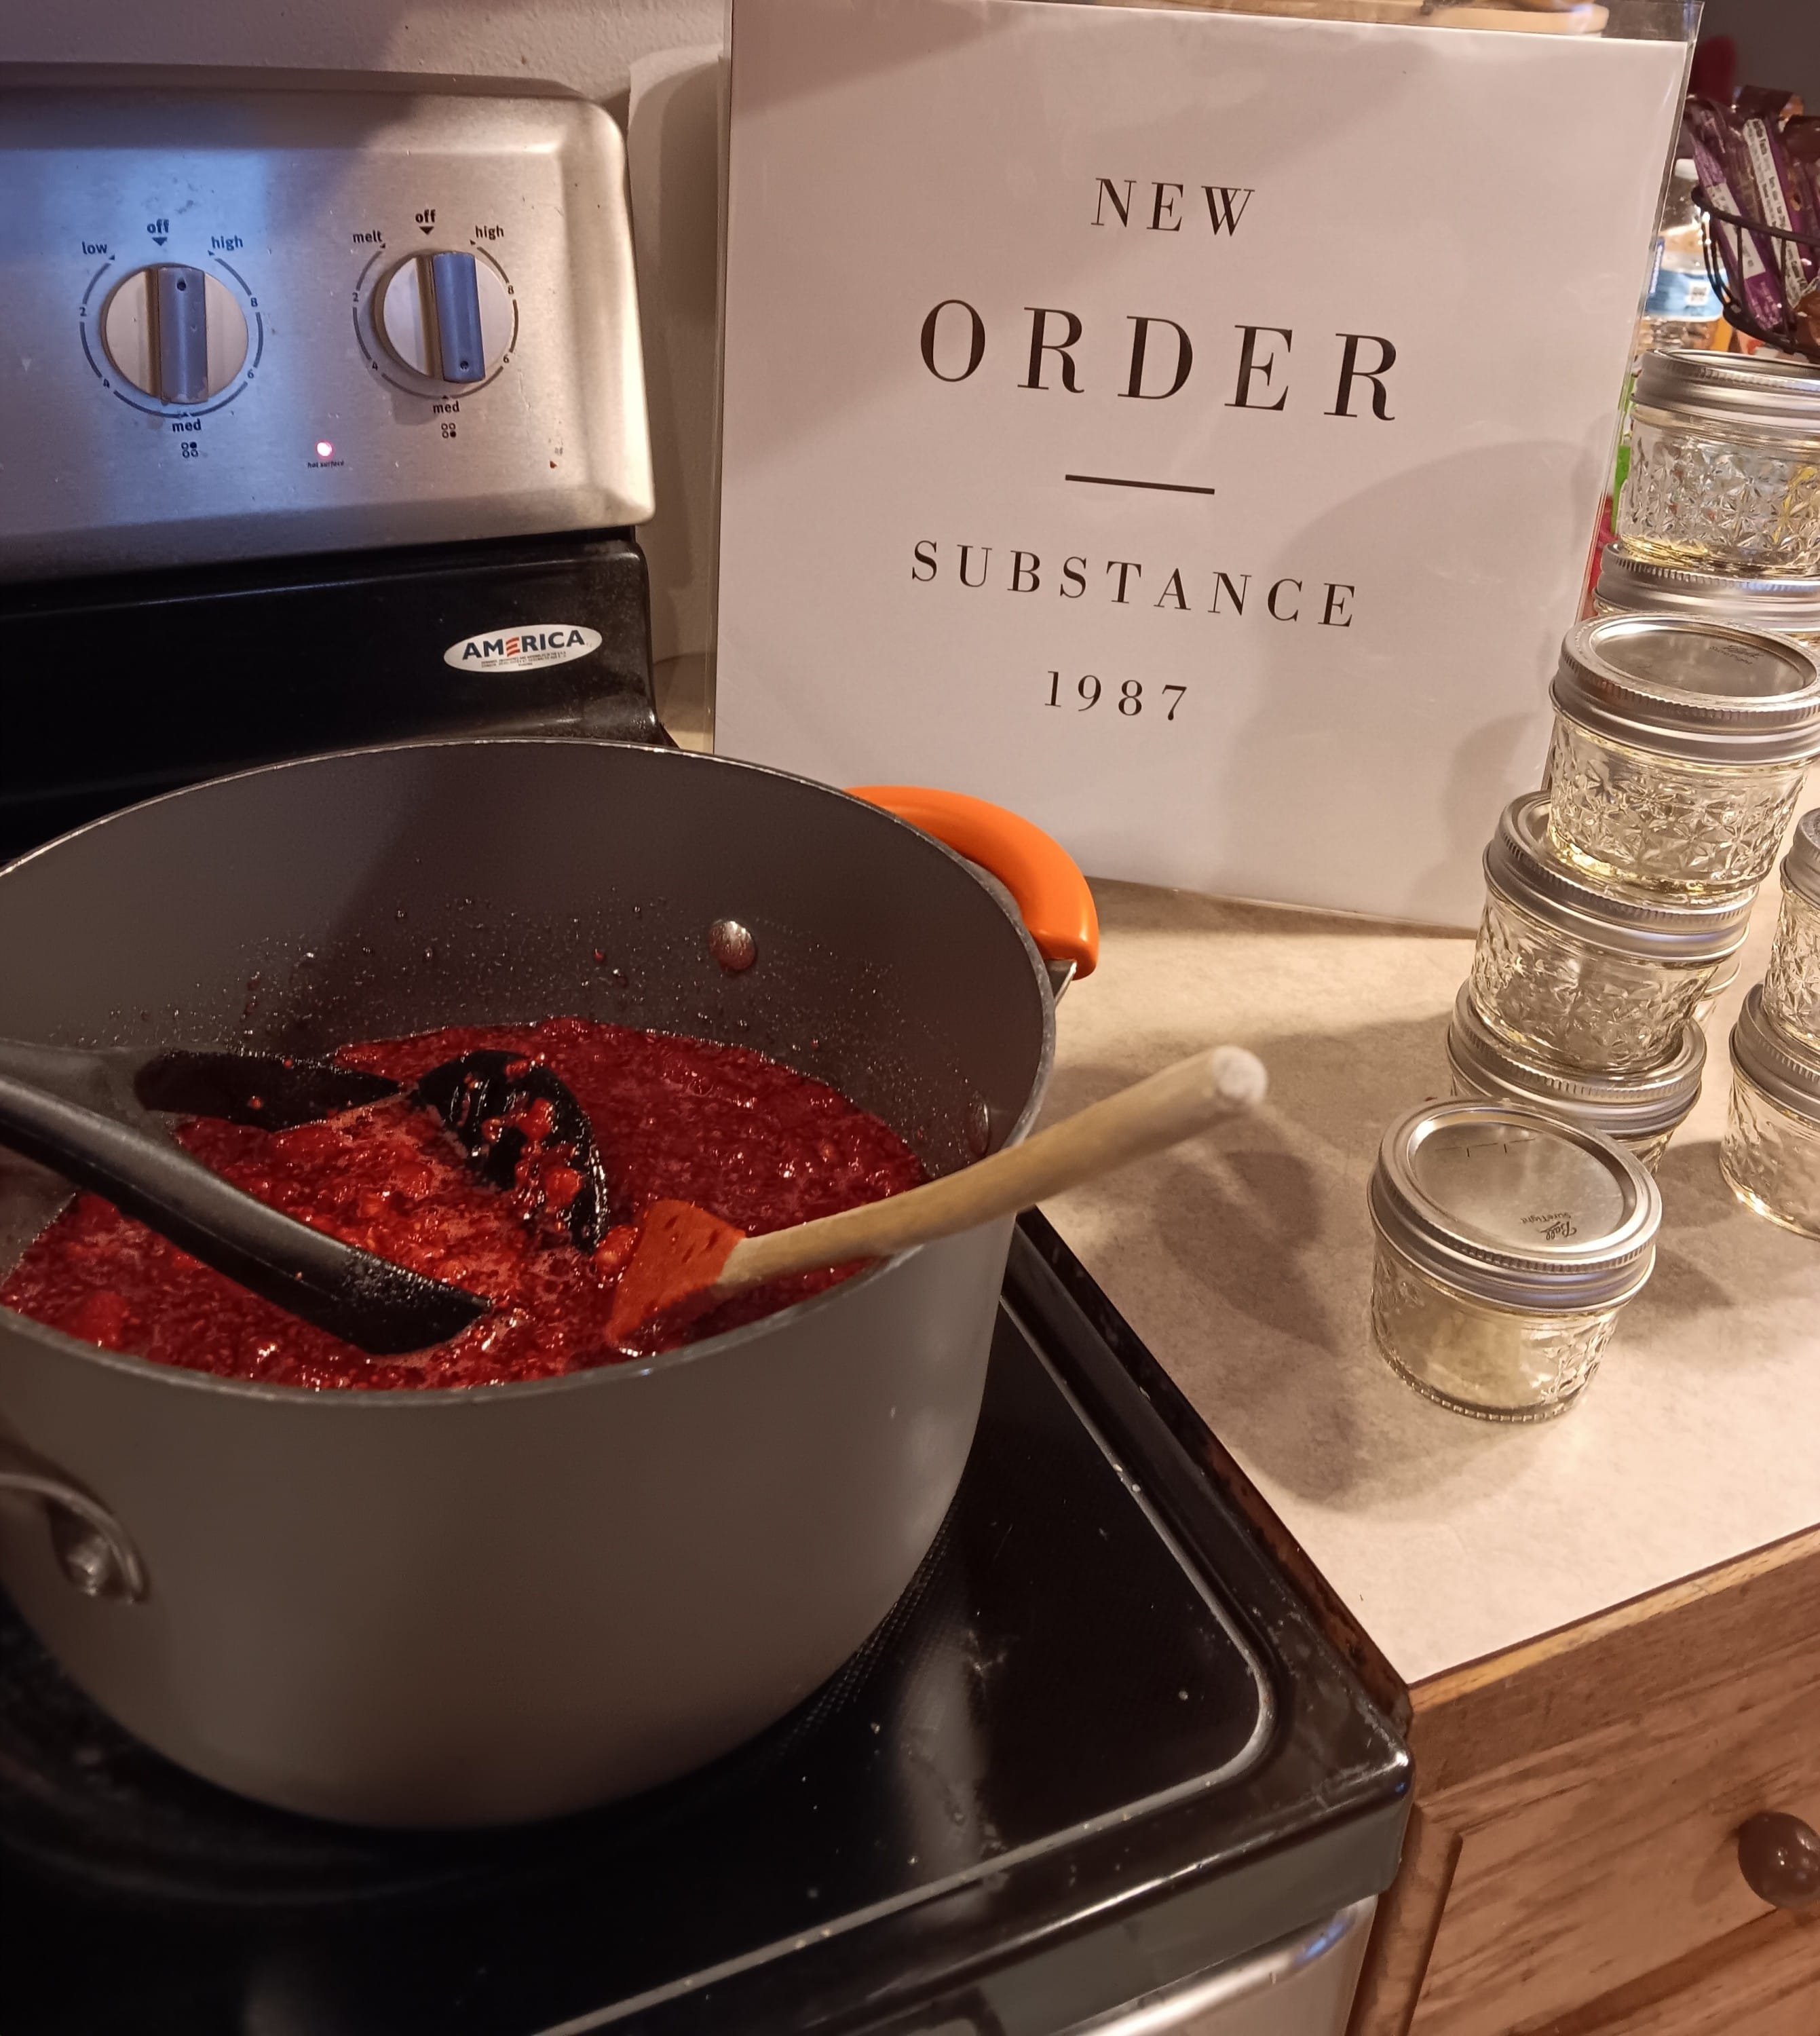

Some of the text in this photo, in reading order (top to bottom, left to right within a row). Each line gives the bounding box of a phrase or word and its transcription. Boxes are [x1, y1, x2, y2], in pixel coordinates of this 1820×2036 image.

[1091, 177, 1255, 237] NEW
[415, 209, 436, 223] off
[147, 219, 170, 233] off
[475, 225, 504, 240] high
[211, 235, 243, 251] high
[352, 230, 383, 244] melt
[81, 242, 107, 255] low
[508, 285, 515, 295] 8
[250, 297, 258, 307] 8
[352, 293, 359, 302] 2
[79, 307, 87, 316] 2
[371, 361, 379, 371] 4
[502, 354, 510, 364] 6
[920, 299, 1397, 421] ORDER
[247, 369, 254, 379] 6
[432, 401, 460, 414] med
[172, 418, 202, 432] med
[911, 540, 1355, 627] SUBSTANCE
[462, 630, 585, 660] AMERICA
[1044, 670, 1188, 721] 1987
[1540, 1221, 1577, 1241] Ball
